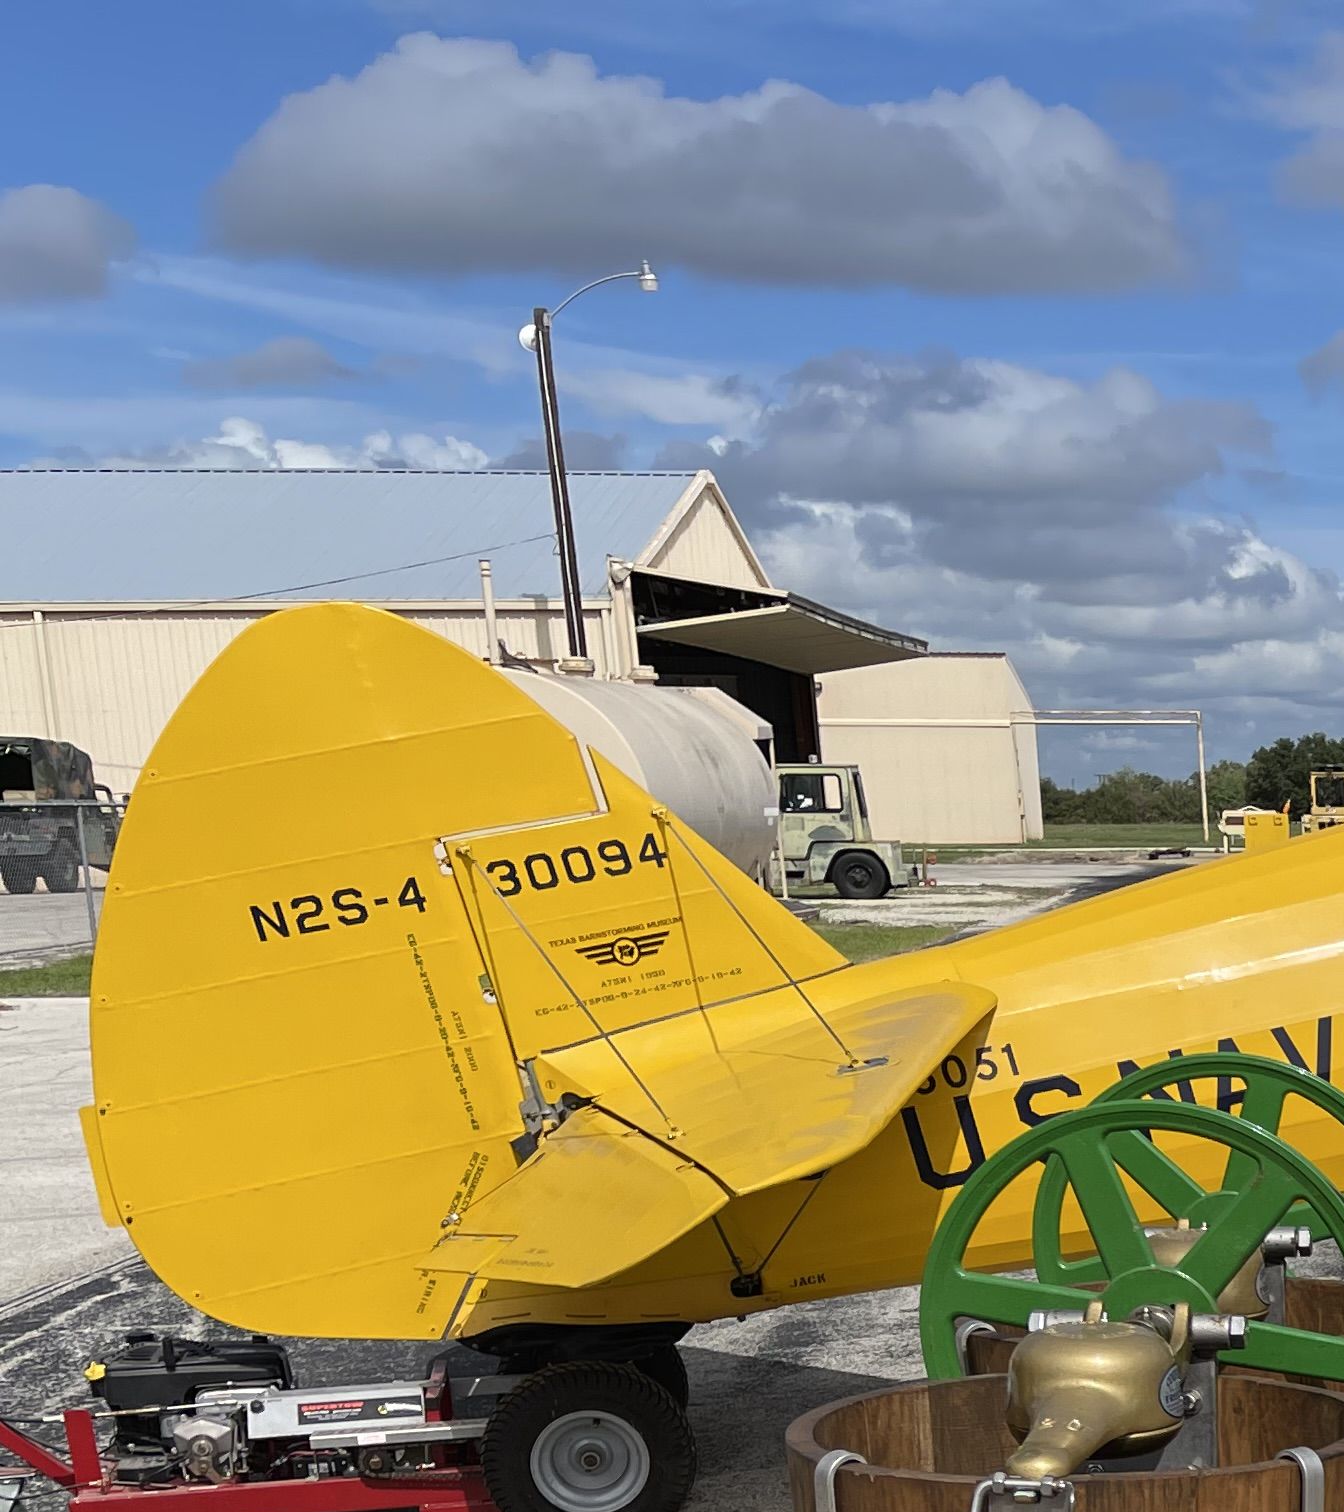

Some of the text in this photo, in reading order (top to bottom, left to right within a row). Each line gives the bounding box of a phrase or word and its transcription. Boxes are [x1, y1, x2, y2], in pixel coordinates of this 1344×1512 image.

[249, 832, 669, 941] N2S-4 30094
[789, 1273, 828, 1289] JACK
